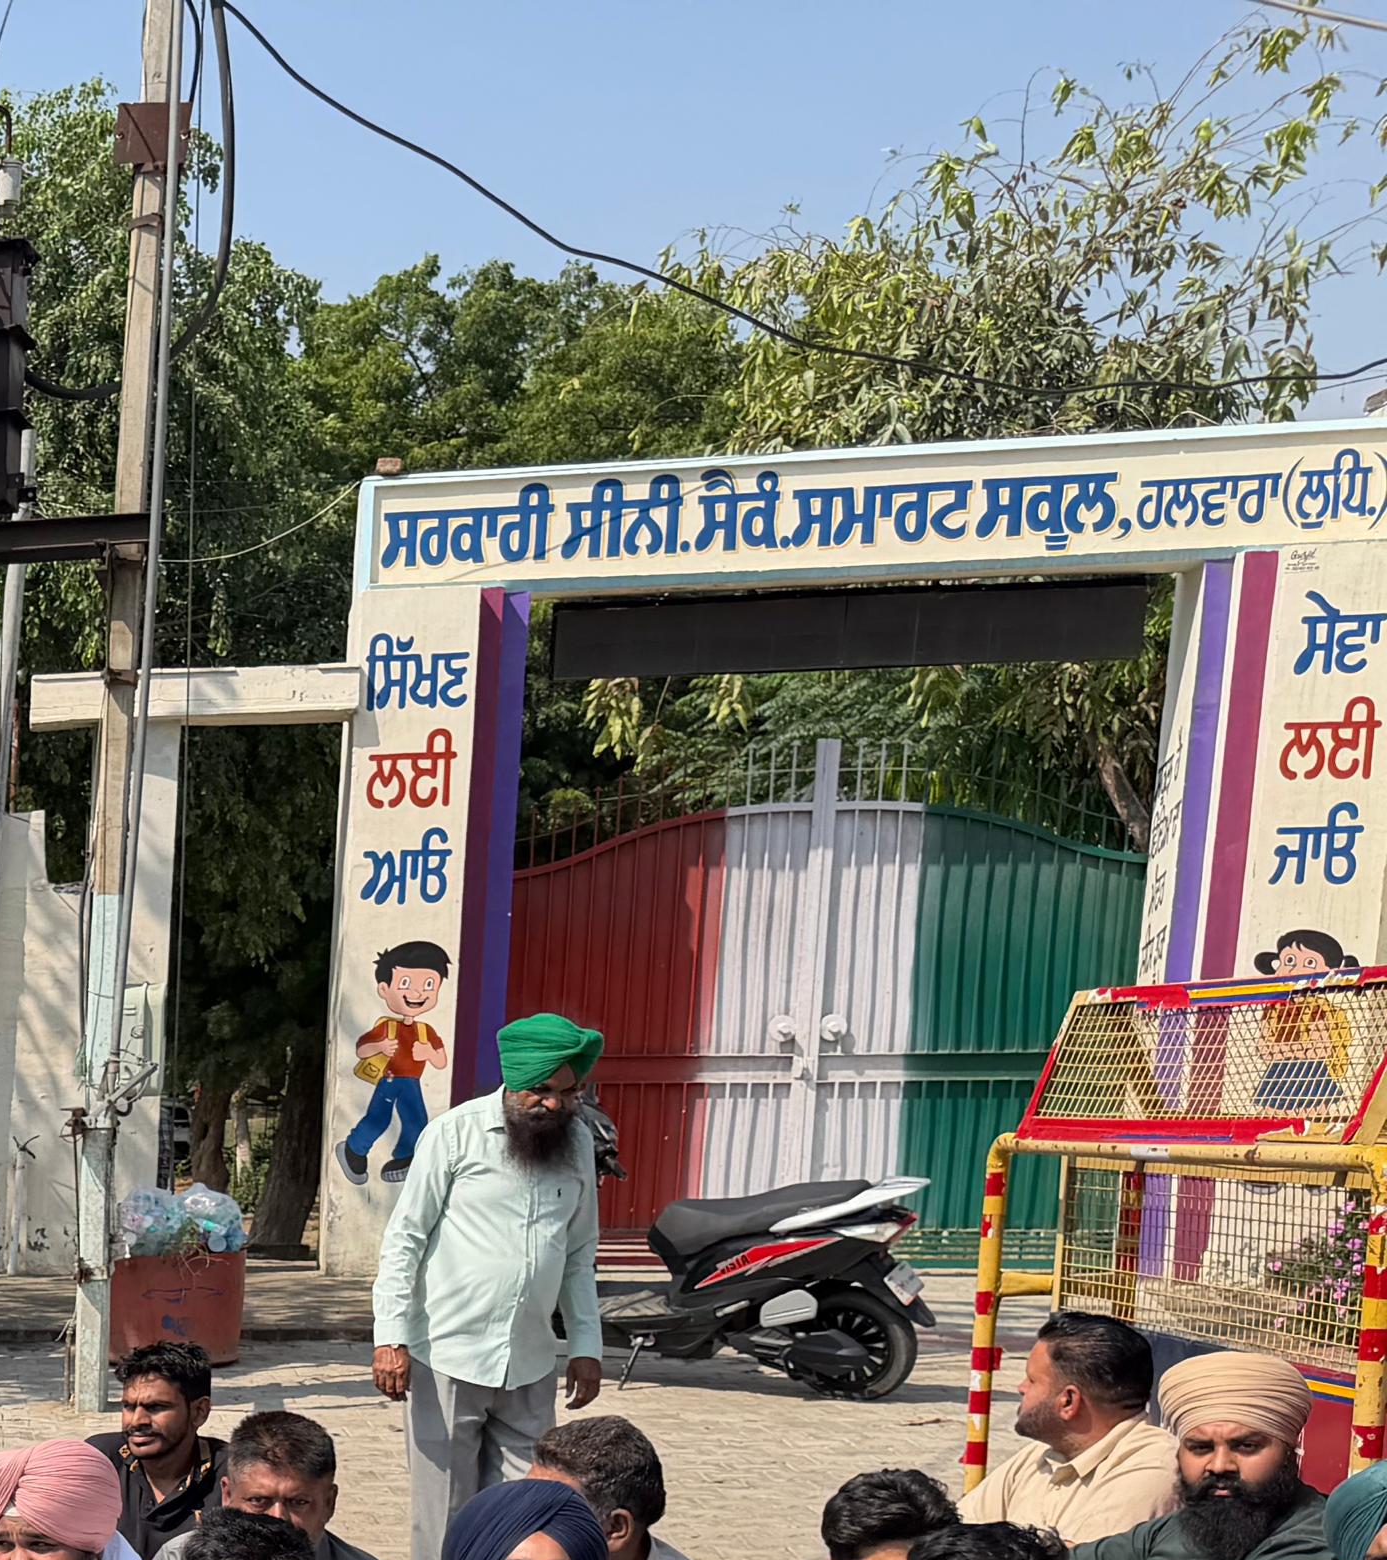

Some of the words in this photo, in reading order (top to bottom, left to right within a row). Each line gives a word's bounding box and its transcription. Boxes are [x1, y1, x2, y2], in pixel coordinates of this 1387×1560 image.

[380, 482, 555, 568] ਸਰਕਾਰੀ
[366, 633, 470, 711] ਸਿੱਖਣ
[1293, 590, 1387, 675] ਸੇਵਾ
[366, 728, 458, 809] ਲਈ
[1279, 696, 1382, 781] ਲਈ
[360, 827, 452, 905] ਆਓ
[1268, 801, 1365, 885] ਜਾਓ
